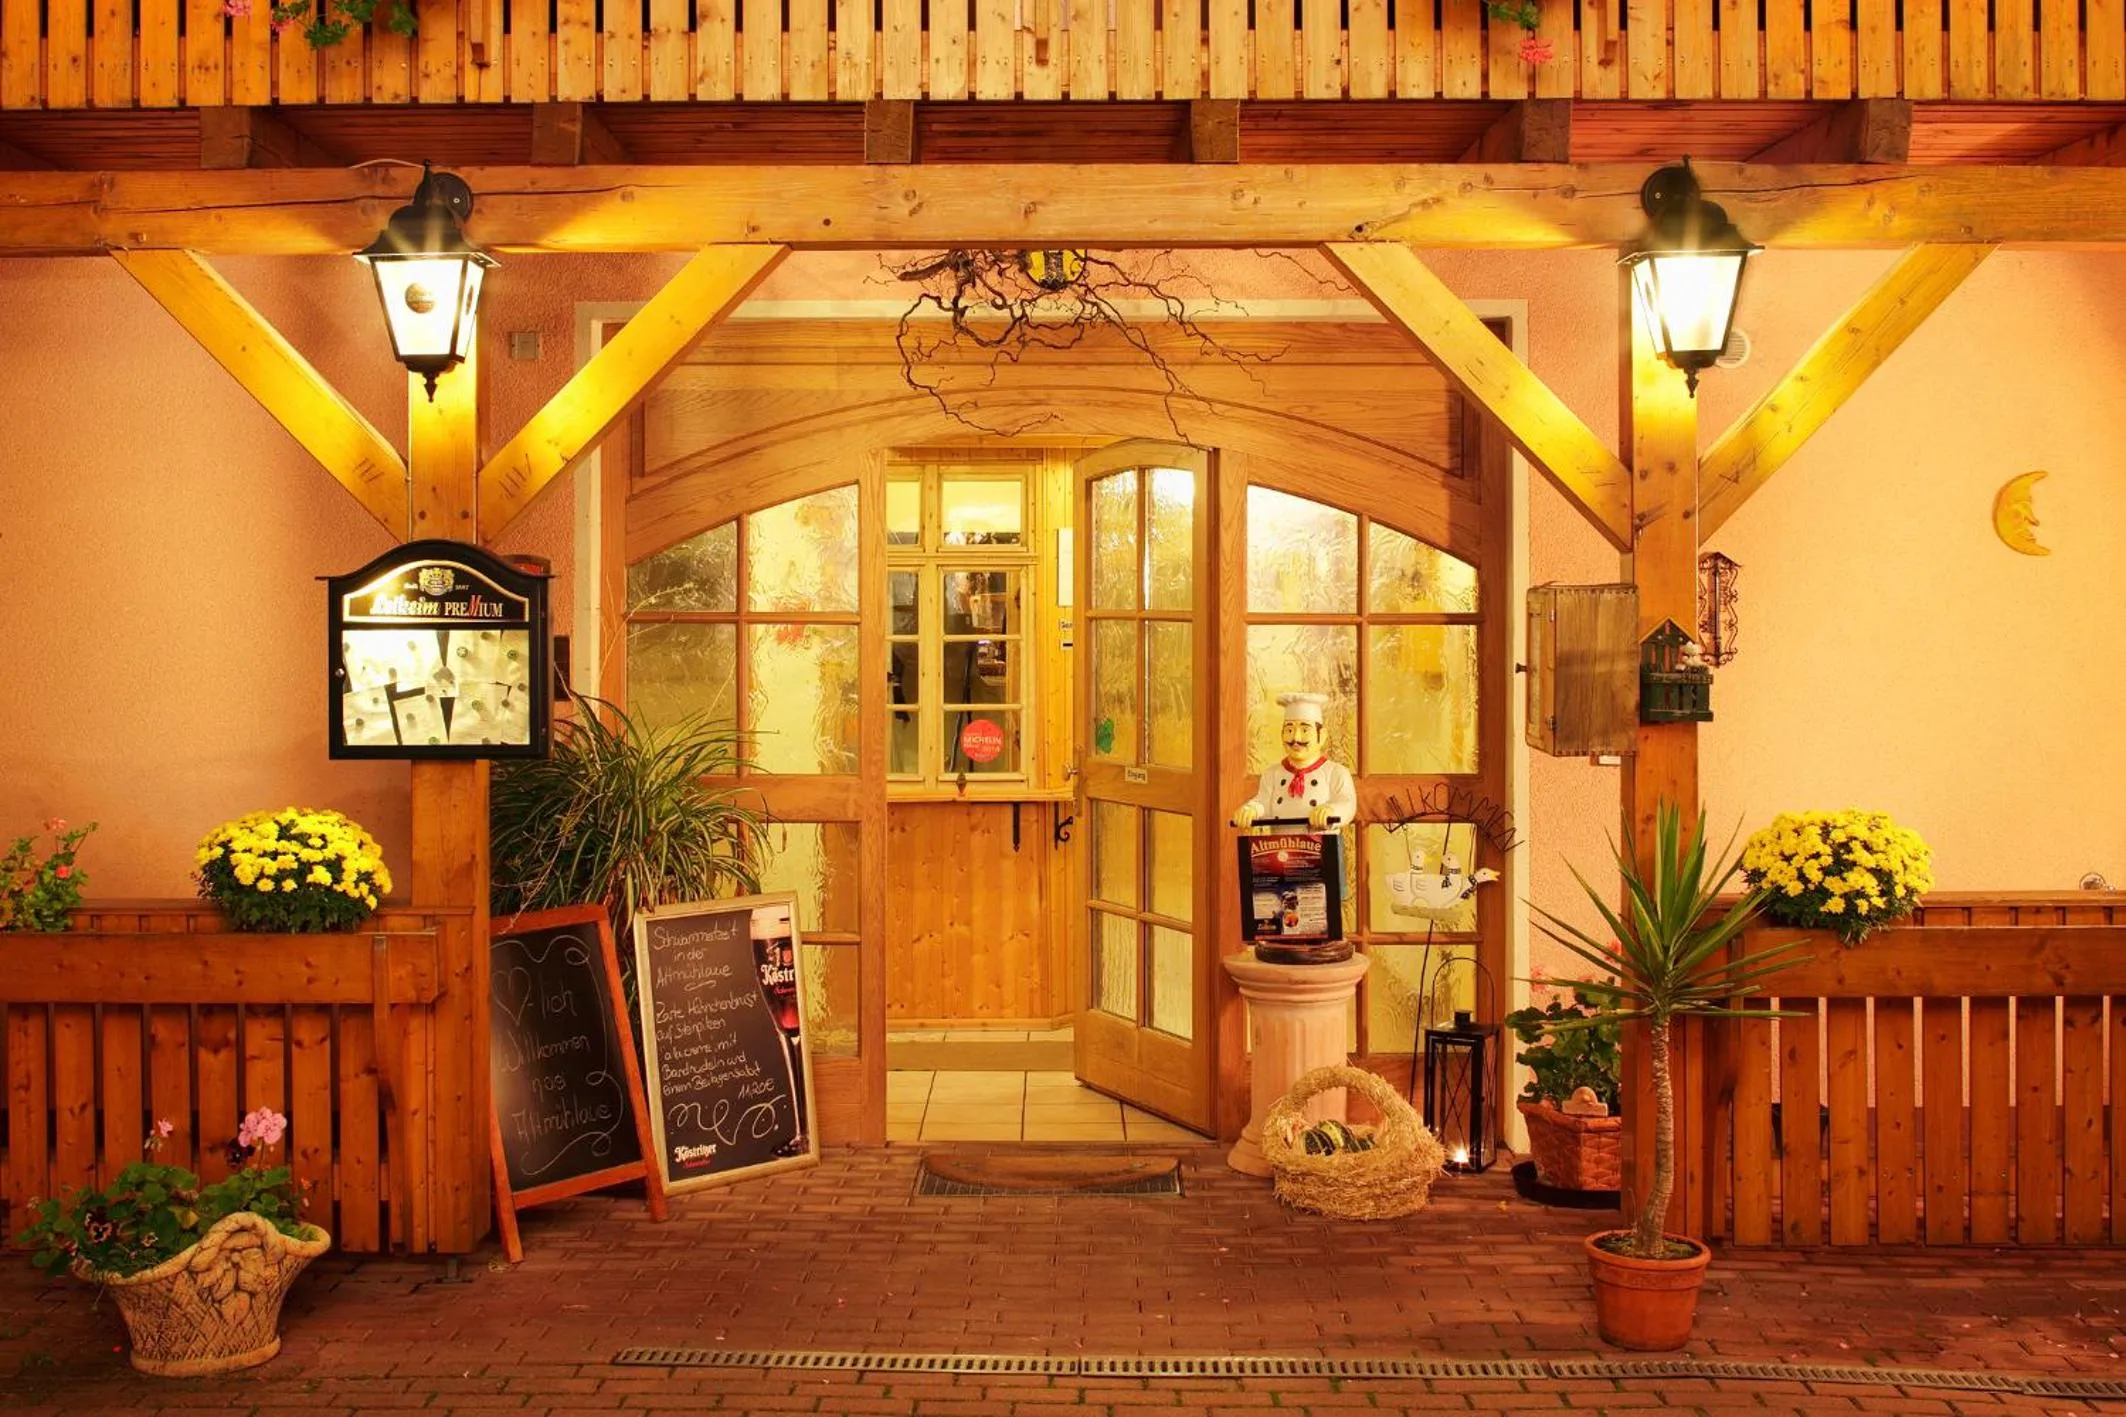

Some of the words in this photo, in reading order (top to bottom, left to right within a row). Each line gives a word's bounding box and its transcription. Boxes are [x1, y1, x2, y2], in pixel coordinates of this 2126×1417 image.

[443, 595, 503, 617] PREMIUM
[963, 735, 1002, 745] MICHELIN
[1250, 837, 1321, 854] Altmühlaue
